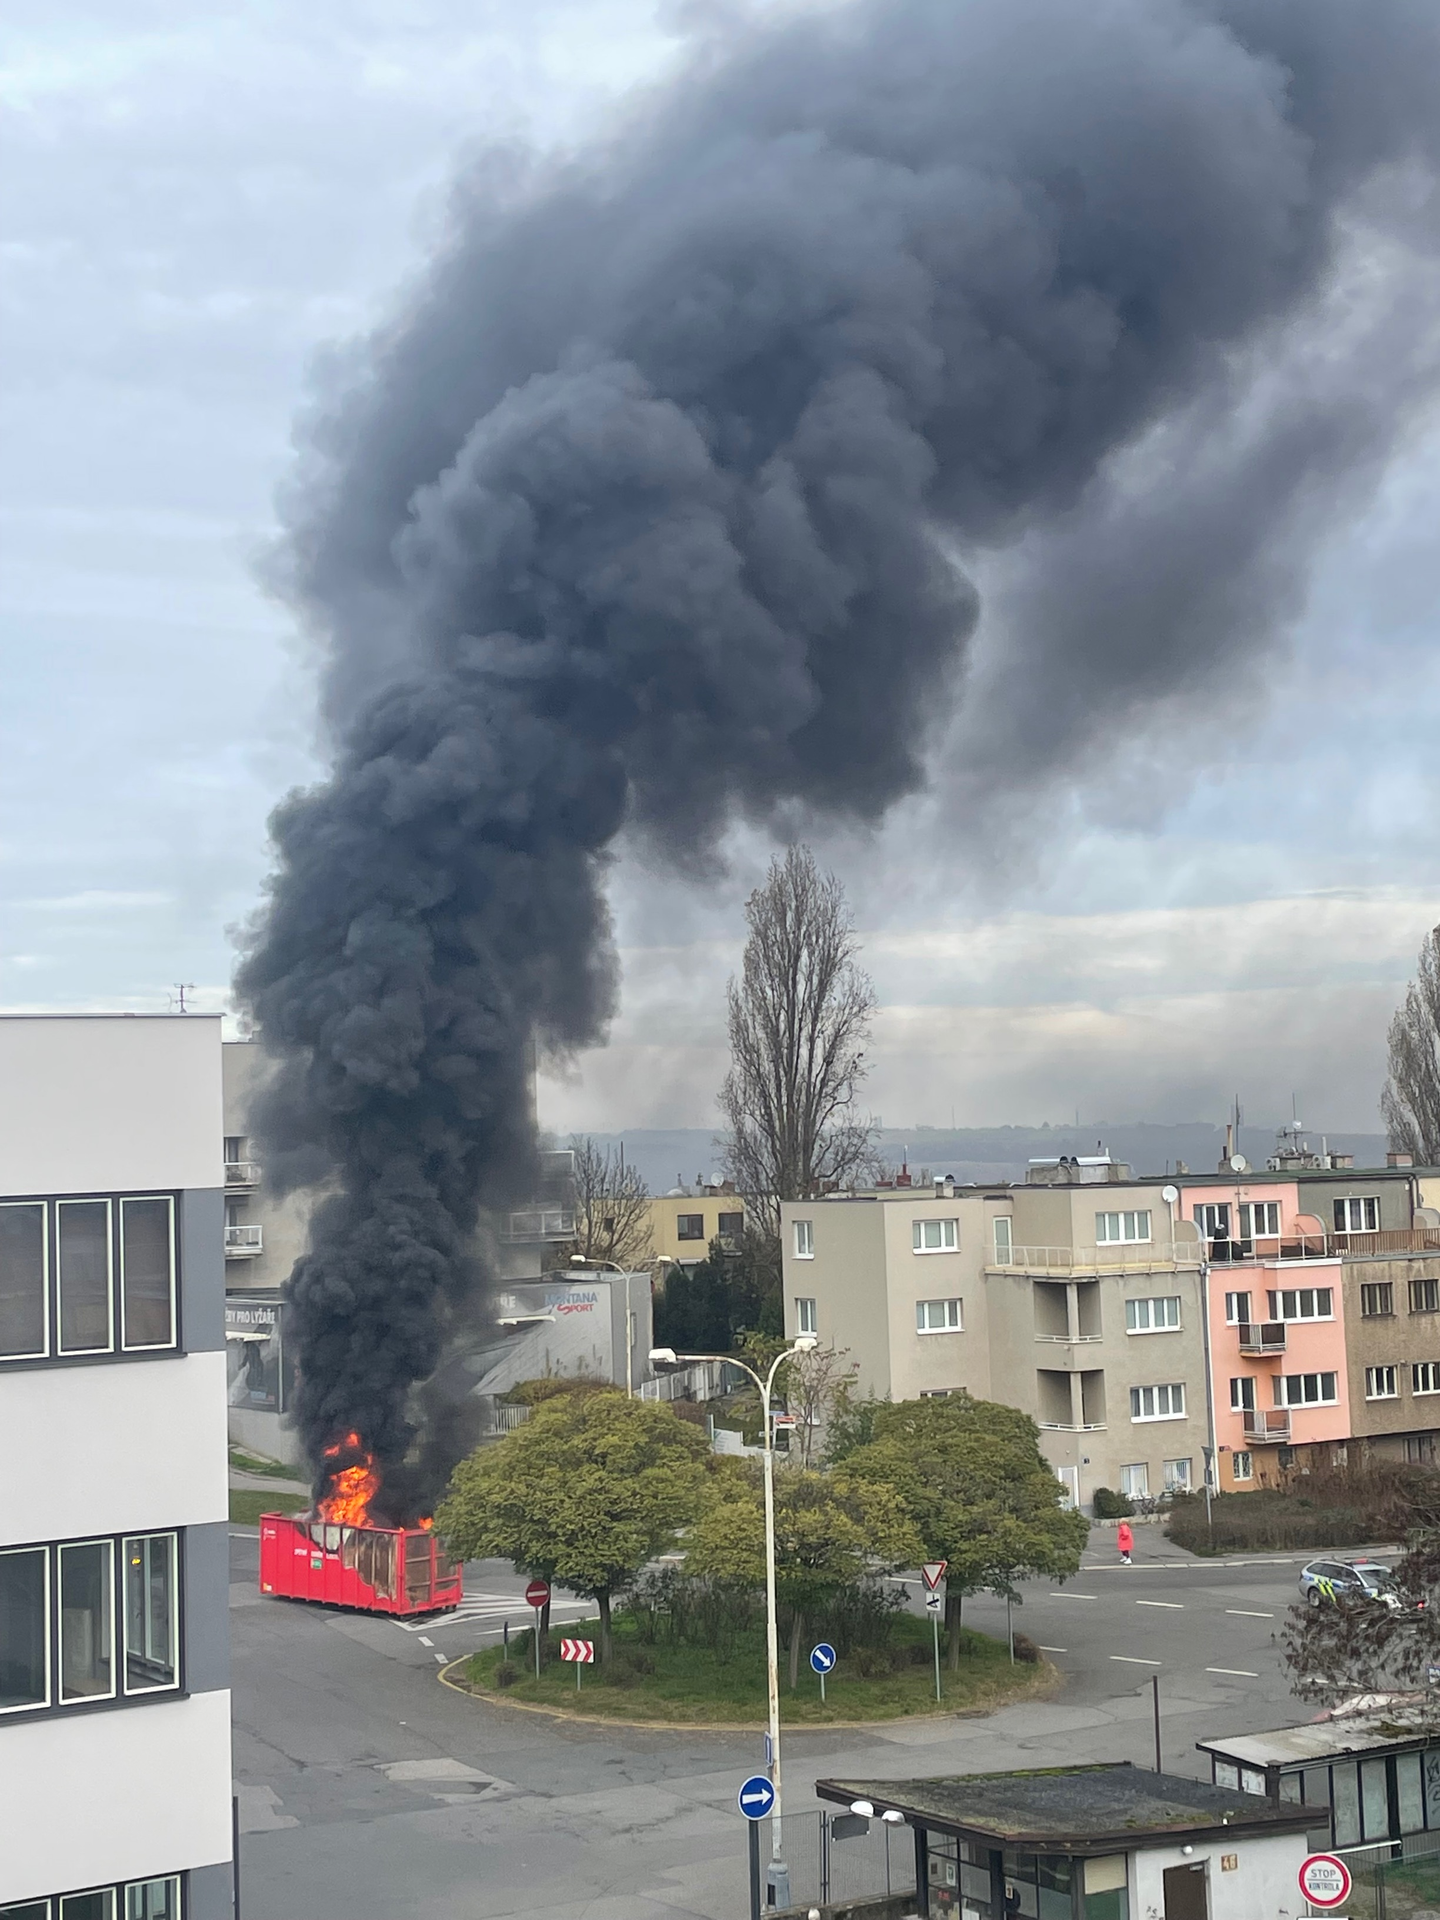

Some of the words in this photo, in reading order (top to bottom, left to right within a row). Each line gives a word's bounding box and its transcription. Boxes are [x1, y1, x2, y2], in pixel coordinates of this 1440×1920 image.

[545, 1292, 598, 1305] MONTANA
[557, 1303, 594, 1315] SPORT
[237, 1310, 250, 1324] PRO
[251, 1307, 275, 1324] LYŽAŘE
[1311, 1869, 1336, 1878] STOP
[1309, 1882, 1340, 1891] KONTROLA
